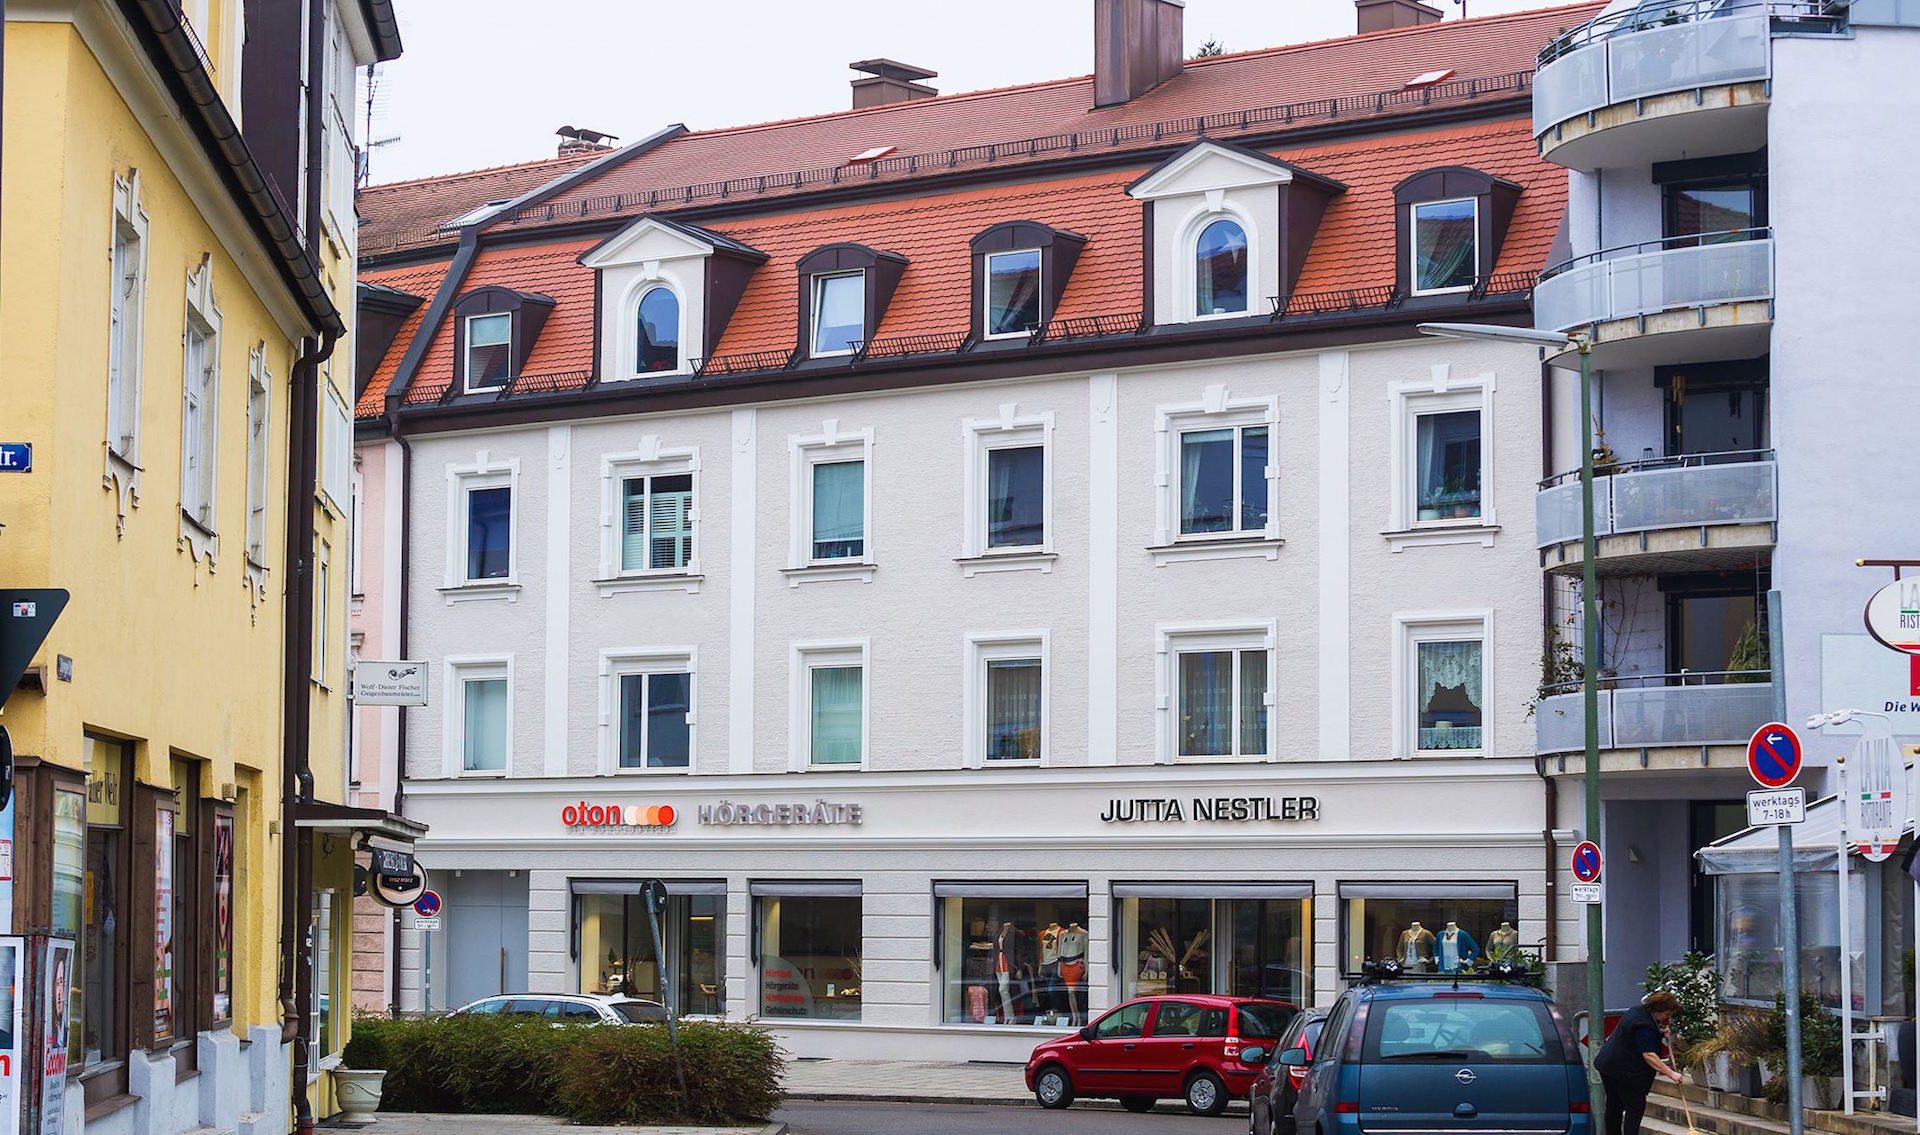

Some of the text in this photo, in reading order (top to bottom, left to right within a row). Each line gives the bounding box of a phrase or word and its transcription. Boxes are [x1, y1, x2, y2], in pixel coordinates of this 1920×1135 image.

[1884, 701, 1906, 712] Die
[1100, 796, 1319, 821] JUTTA NESTLER
[1753, 796, 1800, 808] werktags
[561, 798, 864, 826] oton HÖRGERÄTE
